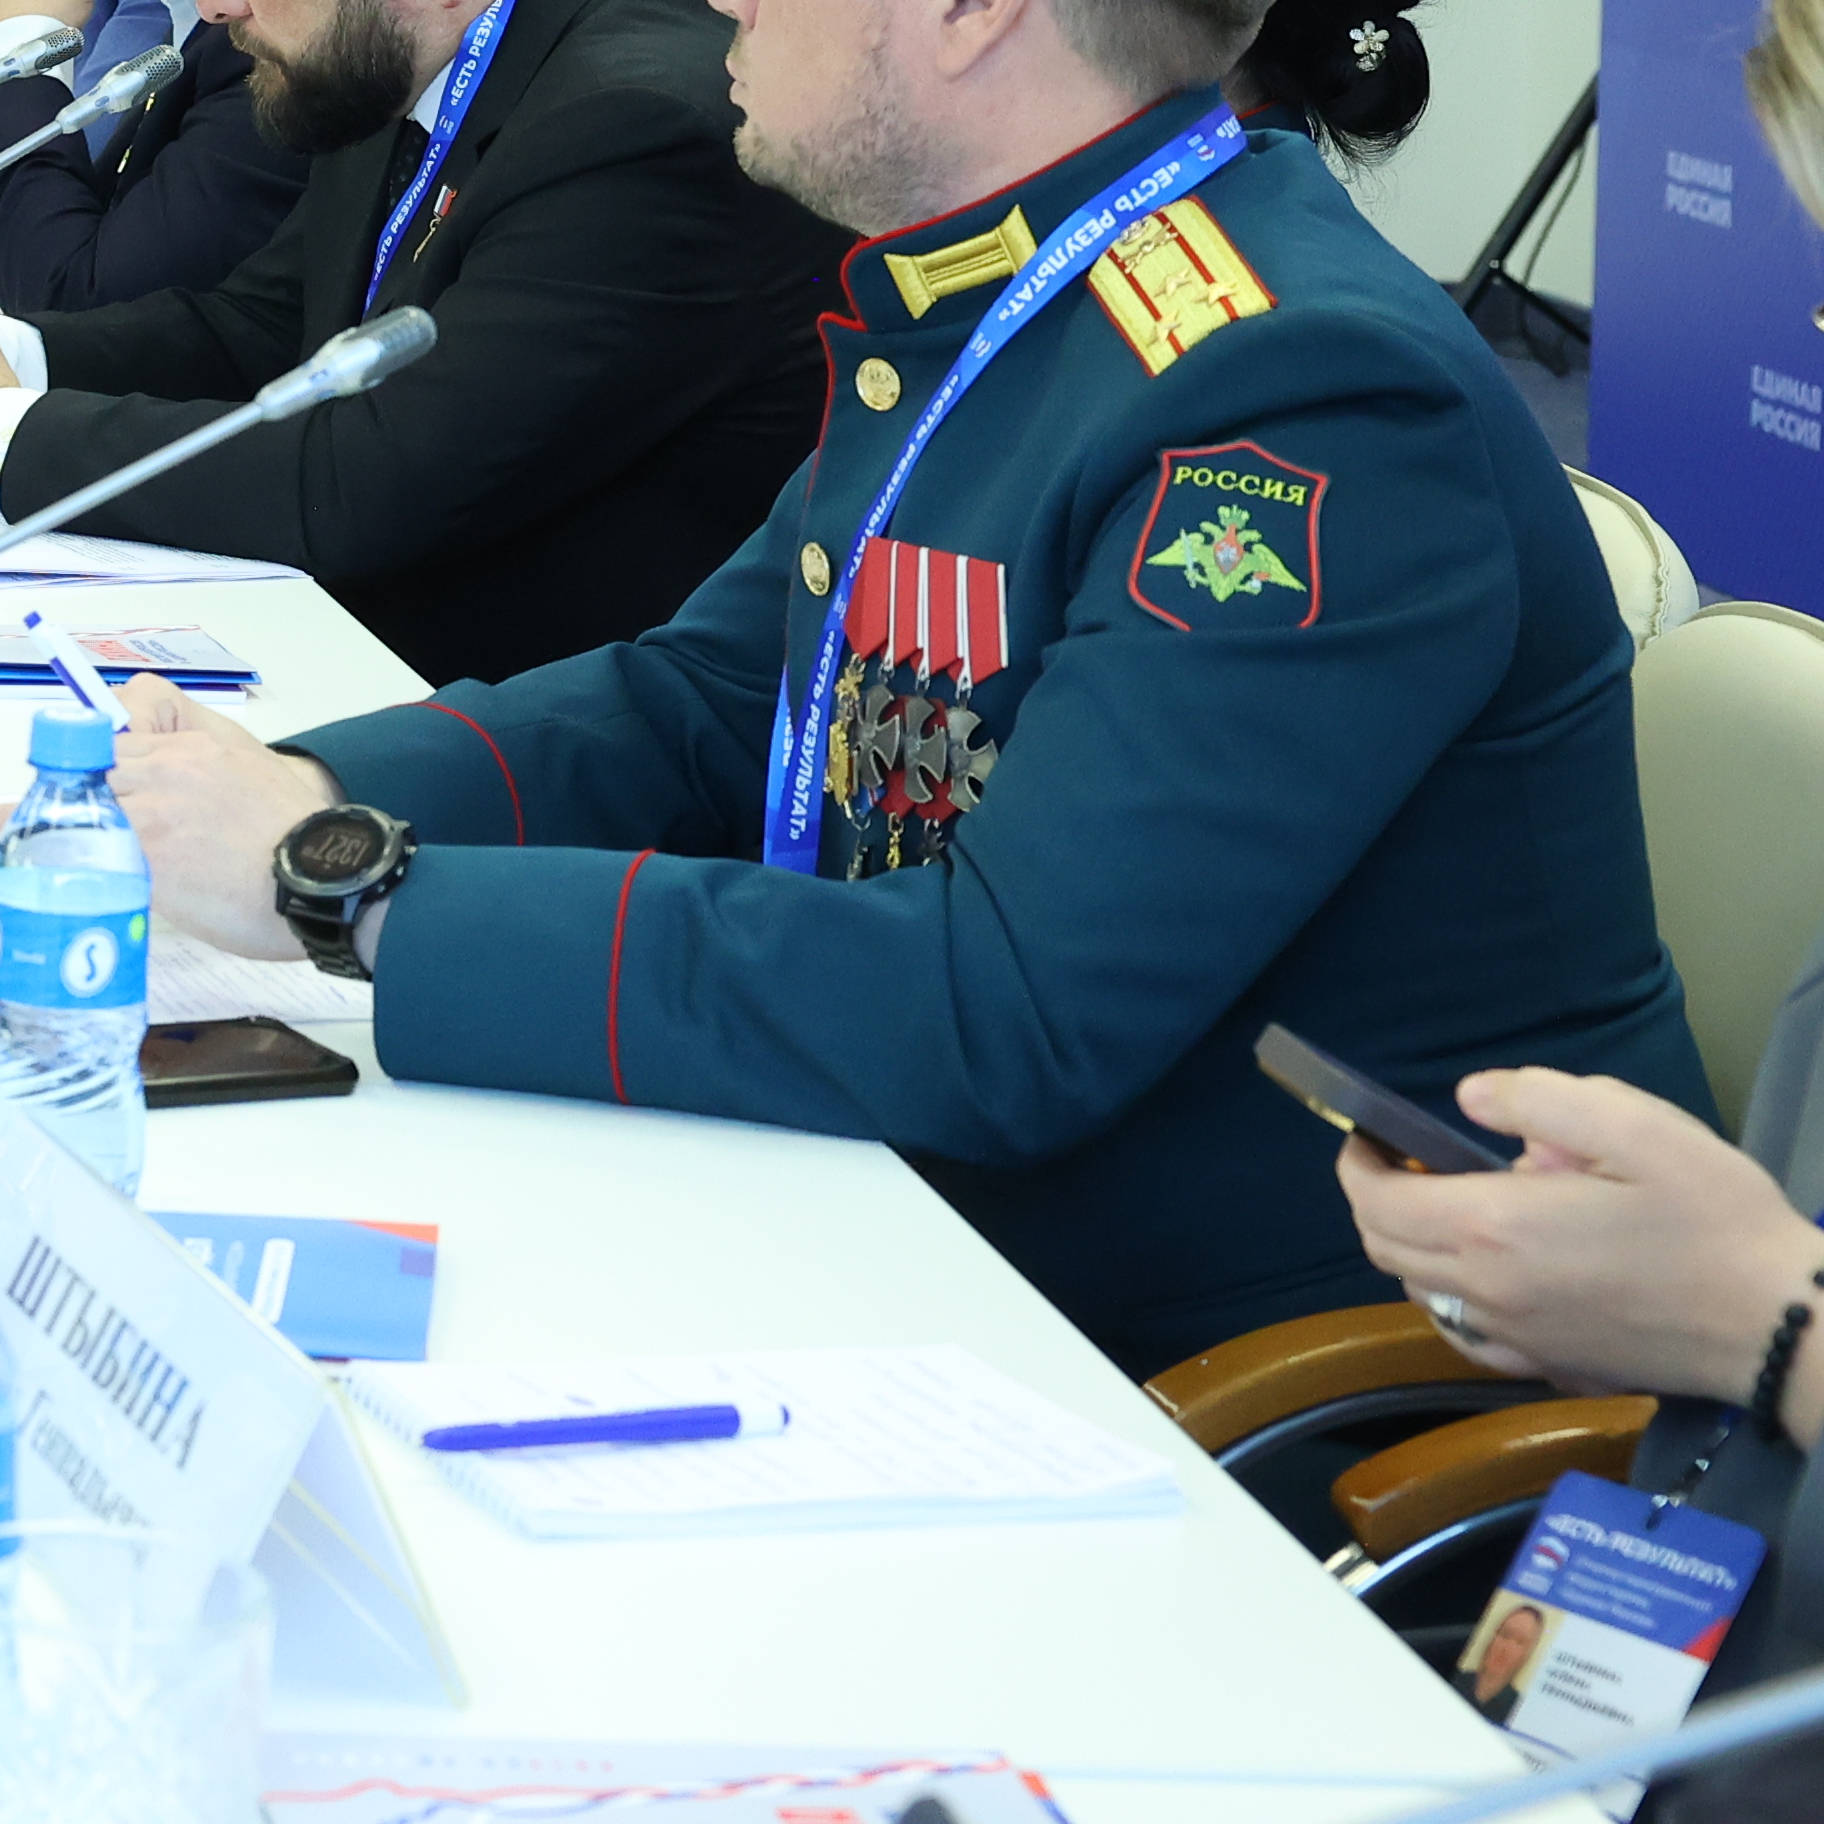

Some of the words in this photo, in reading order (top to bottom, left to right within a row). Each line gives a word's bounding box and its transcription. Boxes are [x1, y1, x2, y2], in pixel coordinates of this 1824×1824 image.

[450, 60, 478, 107] «ЕСТЬ
[391, 142, 442, 236] РЕЗУЛЬТАТ»
[1114, 161, 1181, 214] «ЕСТЬ
[998, 208, 1117, 321] РЕЗУЛЬТАТ»
[1172, 465, 1309, 506] РОССИЯ
[812, 630, 835, 701] «ЕСТЬ
[789, 703, 821, 841] РЕЗУЛЬТАТ»
[7, 1235, 206, 1469] ШТЫБИНА
